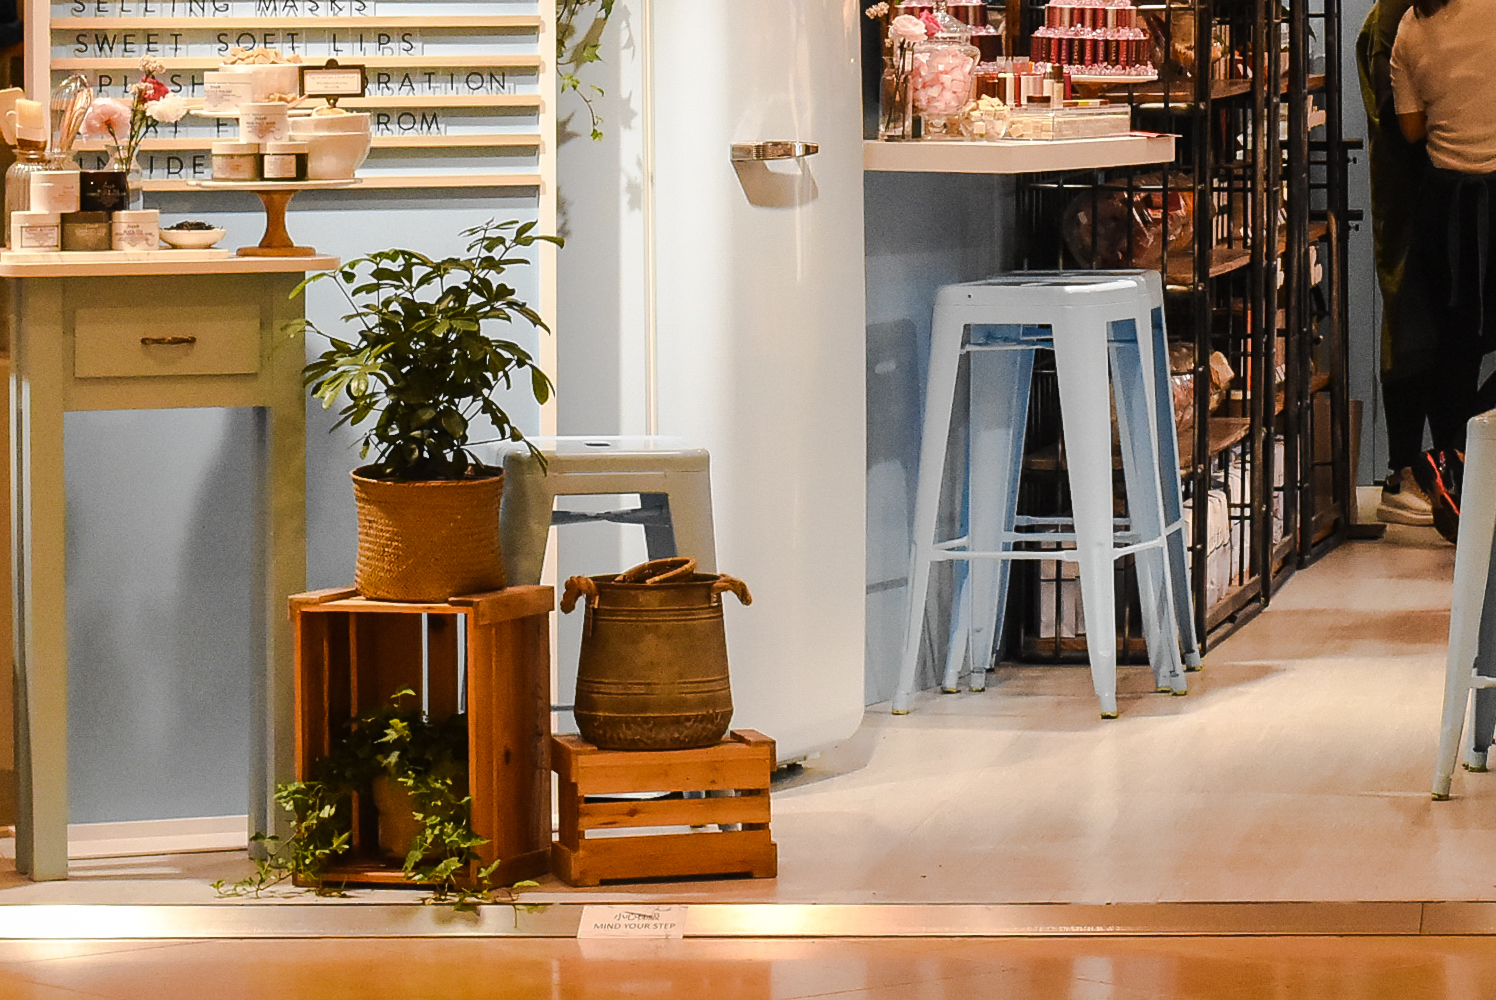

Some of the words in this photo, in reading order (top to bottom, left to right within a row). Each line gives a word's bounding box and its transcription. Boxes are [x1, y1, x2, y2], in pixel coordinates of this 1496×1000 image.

[75, 32, 183, 54] SWEET
[216, 32, 299, 53] SOFT
[332, 32, 414, 52] LIPS
[365, 71, 506, 92] RATION
[79, 155, 206, 175] INIDE
